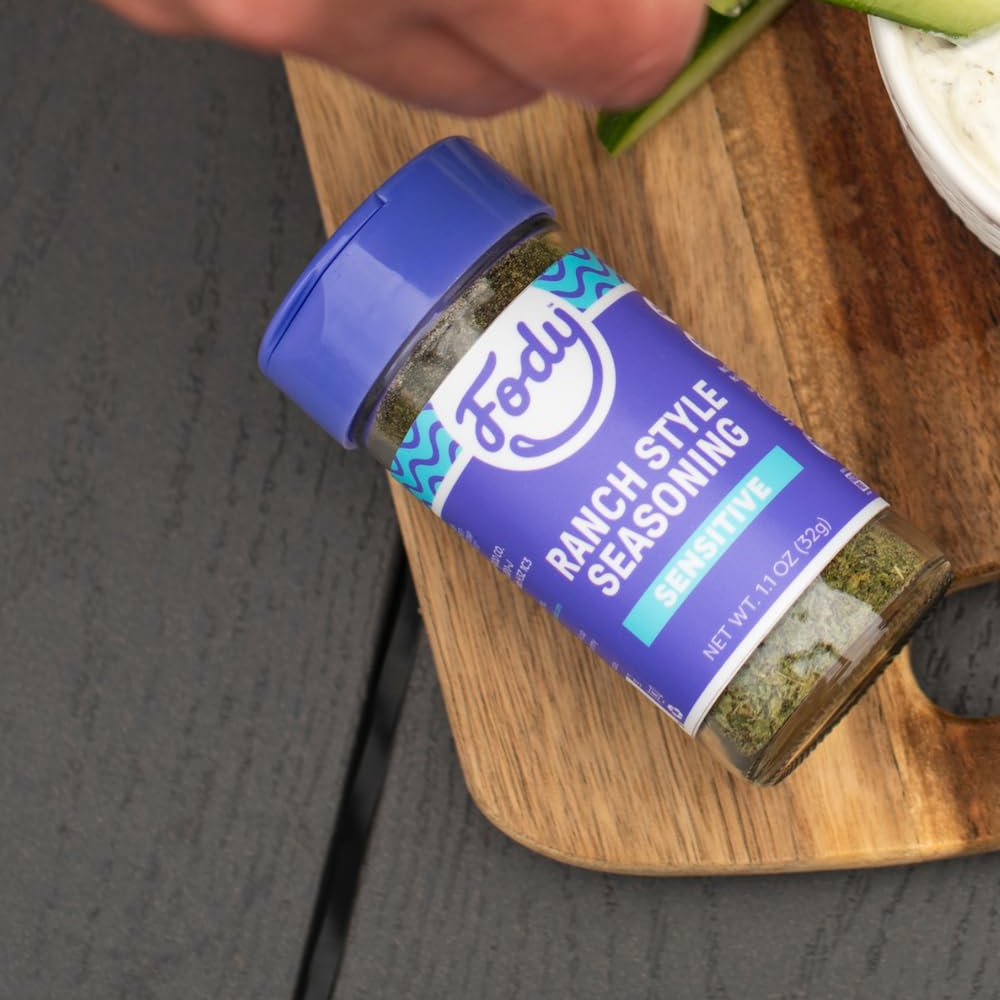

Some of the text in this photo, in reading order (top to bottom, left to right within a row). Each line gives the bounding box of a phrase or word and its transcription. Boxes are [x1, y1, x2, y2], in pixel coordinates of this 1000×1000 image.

[456, 306, 603, 458] Fody
[545, 460, 648, 582] RANCH
[634, 379, 729, 470] STYLE
[587, 417, 750, 597] SEASONING
[653, 475, 773, 609] SENSITIVE
[702, 516, 832, 661] NET WT. 1.1 OZ (32g)
